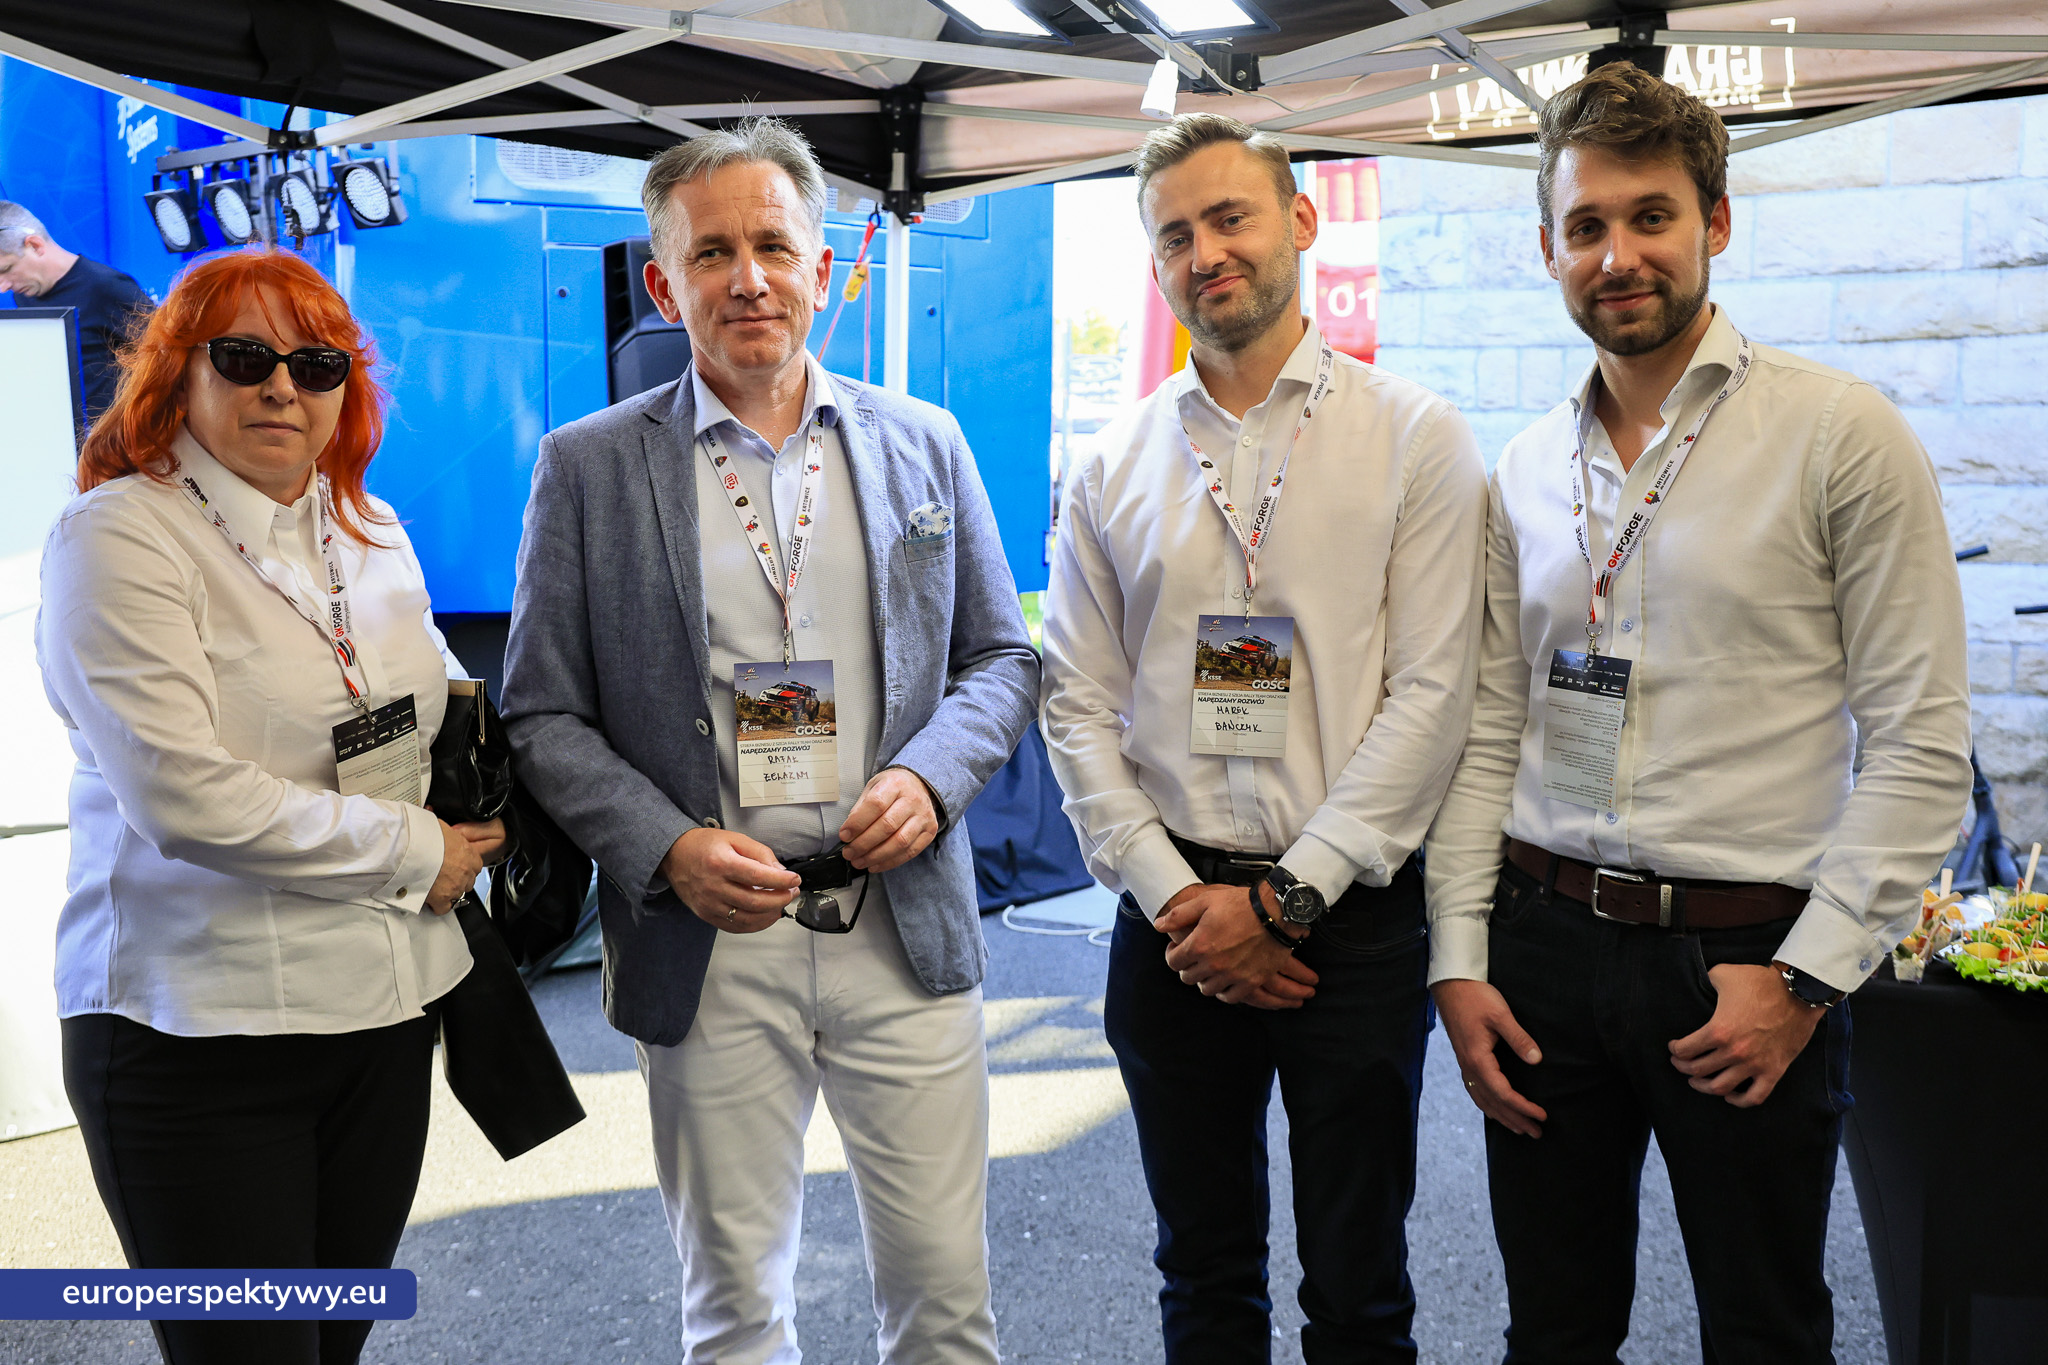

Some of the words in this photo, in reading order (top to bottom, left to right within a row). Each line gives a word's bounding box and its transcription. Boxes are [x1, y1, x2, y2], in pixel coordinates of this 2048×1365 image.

[1327, 284, 1377, 321] 01
[705, 428, 716, 449] POLICJA
[1250, 495, 1272, 547] GKFORGE
[1607, 512, 1643, 569] GKFORGE
[1616, 550, 1631, 572] Kuźnia
[1627, 517, 1651, 554] Przemysłowa
[789, 535, 803, 588] GKFORGE
[331, 601, 344, 638] GKFORGE
[1251, 678, 1287, 691] GOŚĆ
[1197, 697, 1237, 705] NAPĘDZAMY
[1216, 706, 1249, 715] MAREK
[795, 722, 831, 736] GOŚĆ
[740, 746, 781, 755] NAPĘDZAMY
